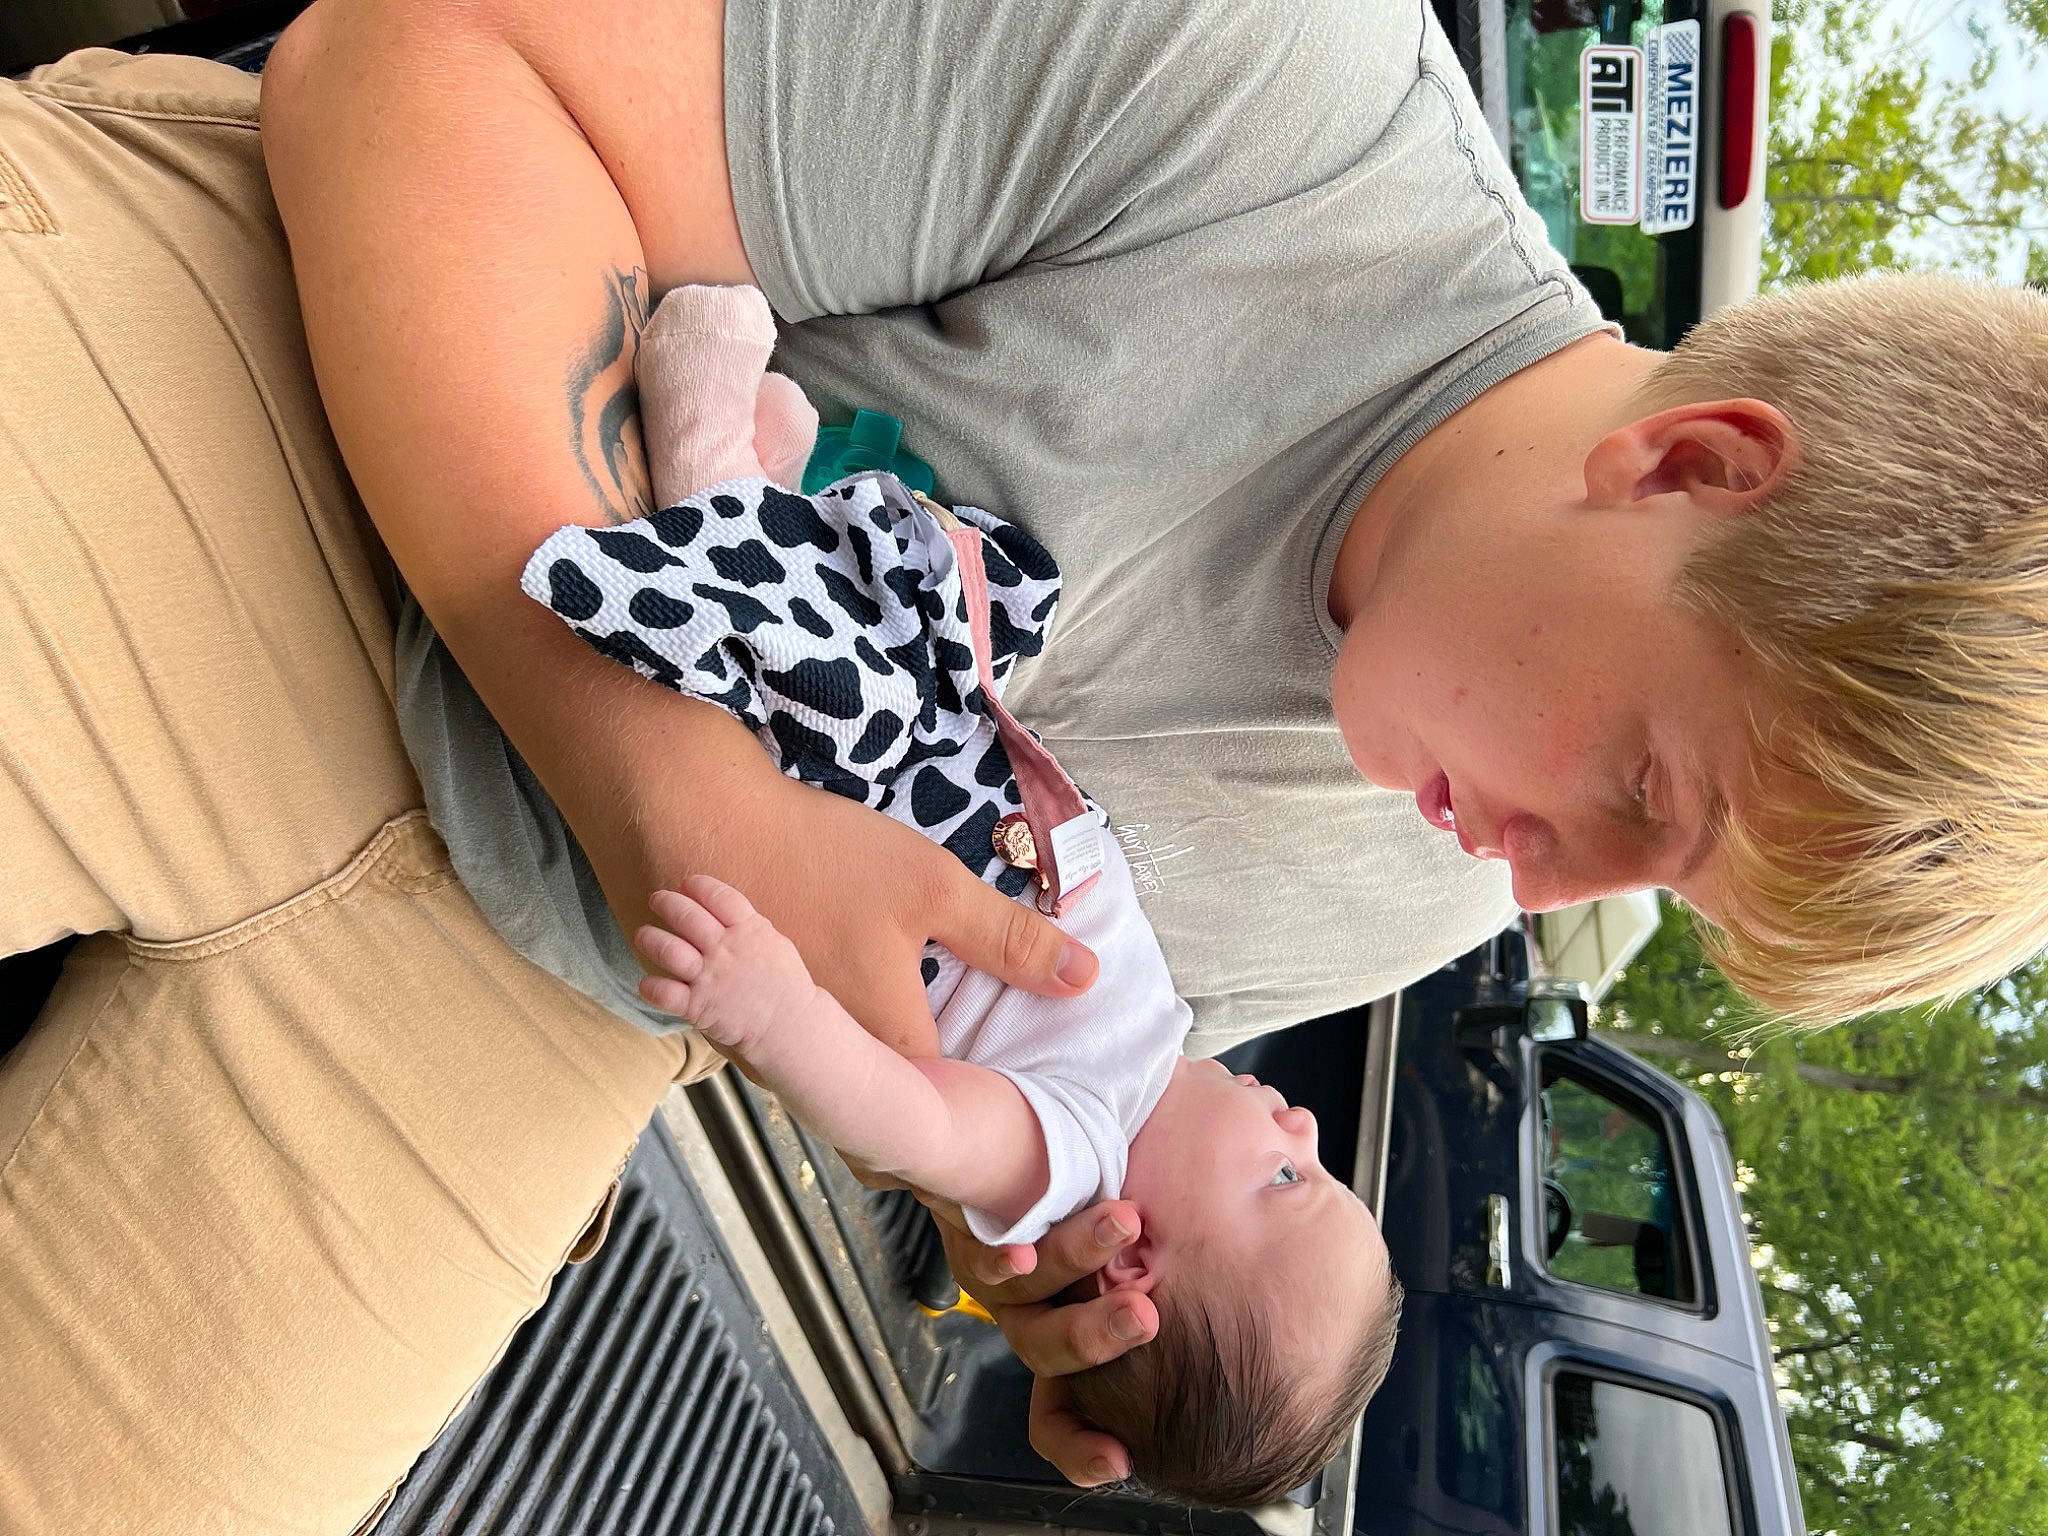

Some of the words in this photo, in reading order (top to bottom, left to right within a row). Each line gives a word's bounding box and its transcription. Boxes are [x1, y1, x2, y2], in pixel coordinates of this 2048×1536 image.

[1591, 57, 1633, 113] ATI
[1647, 39, 1658, 127] COMPONENTS
[1594, 119, 1610, 185] PRODUCTS
[1612, 119, 1630, 213] PERFORMANCE
[1647, 131, 1657, 146] OF
[1664, 63, 1692, 222] MEZIERE
[1594, 190, 1609, 212] INC
[1115, 824, 1151, 850] GUY
